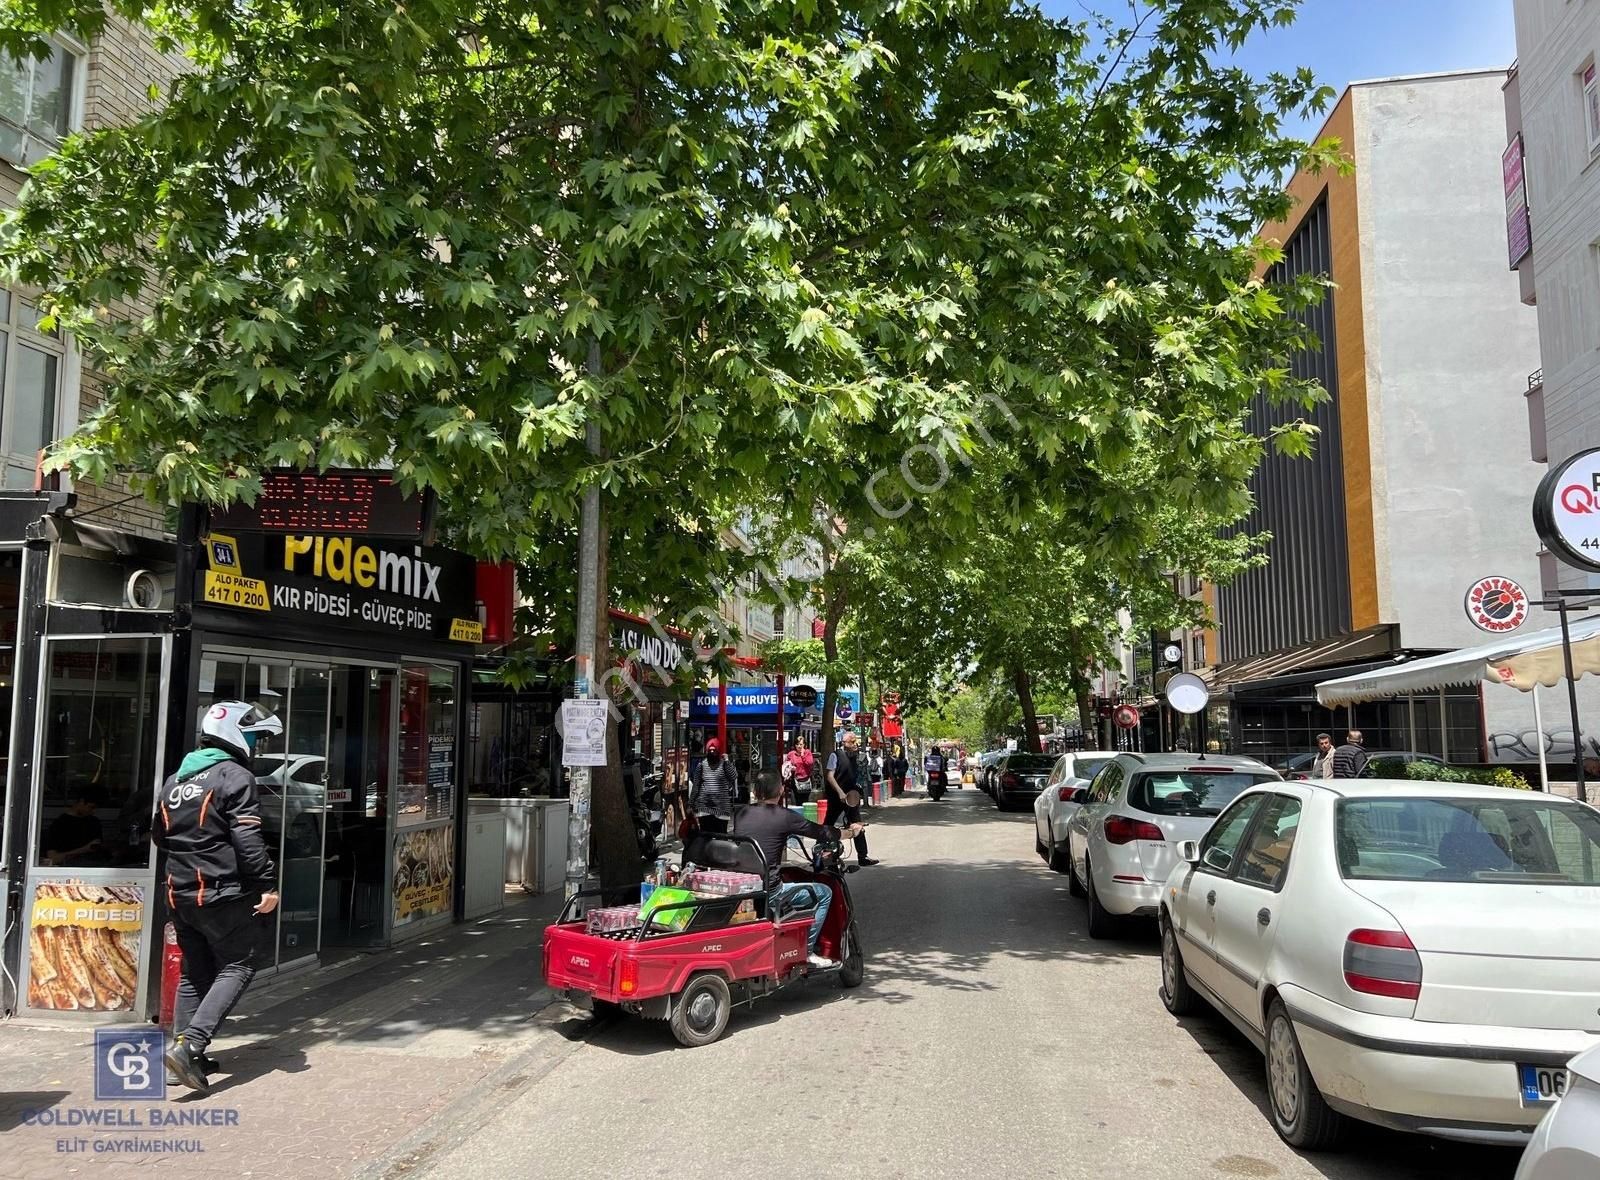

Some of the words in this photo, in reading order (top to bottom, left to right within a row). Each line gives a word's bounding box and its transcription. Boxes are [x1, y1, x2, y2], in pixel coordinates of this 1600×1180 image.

[284, 535, 442, 603] Pidemix
[215, 574, 232, 585] ALO
[233, 577, 259, 589] PAKET
[208, 586, 231, 602] 417
[233, 590, 241, 603] 0
[244, 591, 264, 607] 200
[273, 585, 300, 609] KIR
[303, 586, 351, 617] PİDESİ
[361, 599, 405, 631] GÜVEÇ
[406, 606, 433, 631] PİDE
[456, 620, 465, 628] ALO
[465, 622, 478, 630] PAKET
[453, 629, 464, 639] 417
[465, 630, 470, 640] 0
[470, 631, 481, 641] 200
[697, 695, 733, 706] KONR
[35, 907, 73, 922] KIR
[74, 903, 143, 922] PİDESİ
[702, 944, 722, 953] APEC
[779, 949, 799, 960] APEC
[570, 955, 590, 968] APEC
[1526, 1085, 1538, 1094] TR
